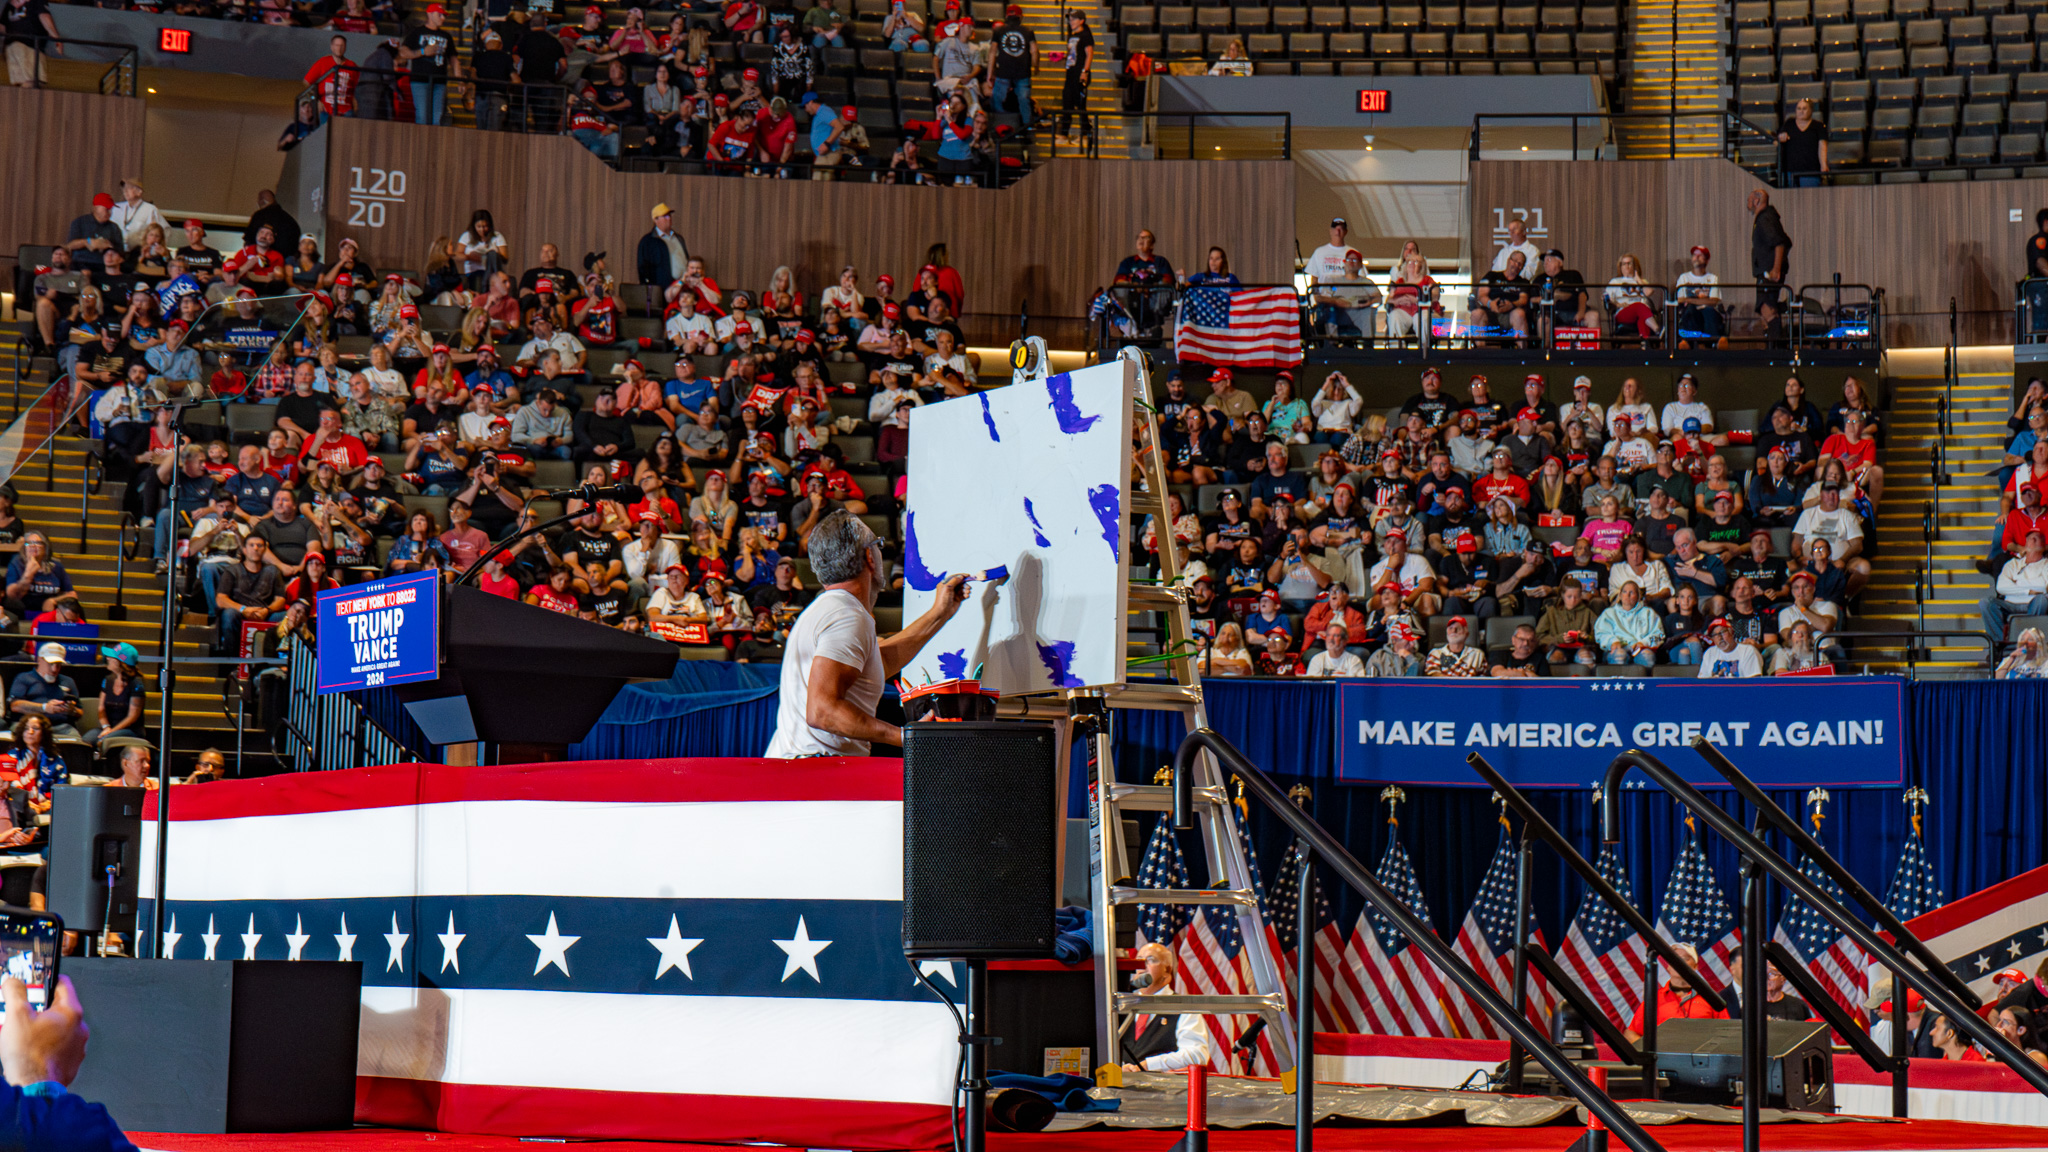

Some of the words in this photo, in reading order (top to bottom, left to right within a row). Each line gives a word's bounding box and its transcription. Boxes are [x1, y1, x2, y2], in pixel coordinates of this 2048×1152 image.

[162, 28, 191, 52] EXIT
[1361, 90, 1387, 112] EXIT
[350, 167, 406, 196] 120
[347, 201, 385, 228] 20
[337, 556, 363, 565] FIGHT
[337, 601, 352, 615] TEXT
[353, 598, 368, 612] NEW
[368, 595, 386, 610] YORK
[386, 593, 396, 605] TO
[396, 589, 416, 604] 88022
[348, 608, 404, 642] TRUMP
[657, 629, 701, 639] SWAMP
[354, 637, 398, 664] VANCE
[366, 671, 385, 686] 2024
[1358, 720, 1456, 746] MAKE
[1464, 722, 1623, 748] AMERICA
[1631, 721, 1750, 748] GREAT
[1758, 719, 1883, 747] AGAIN!
